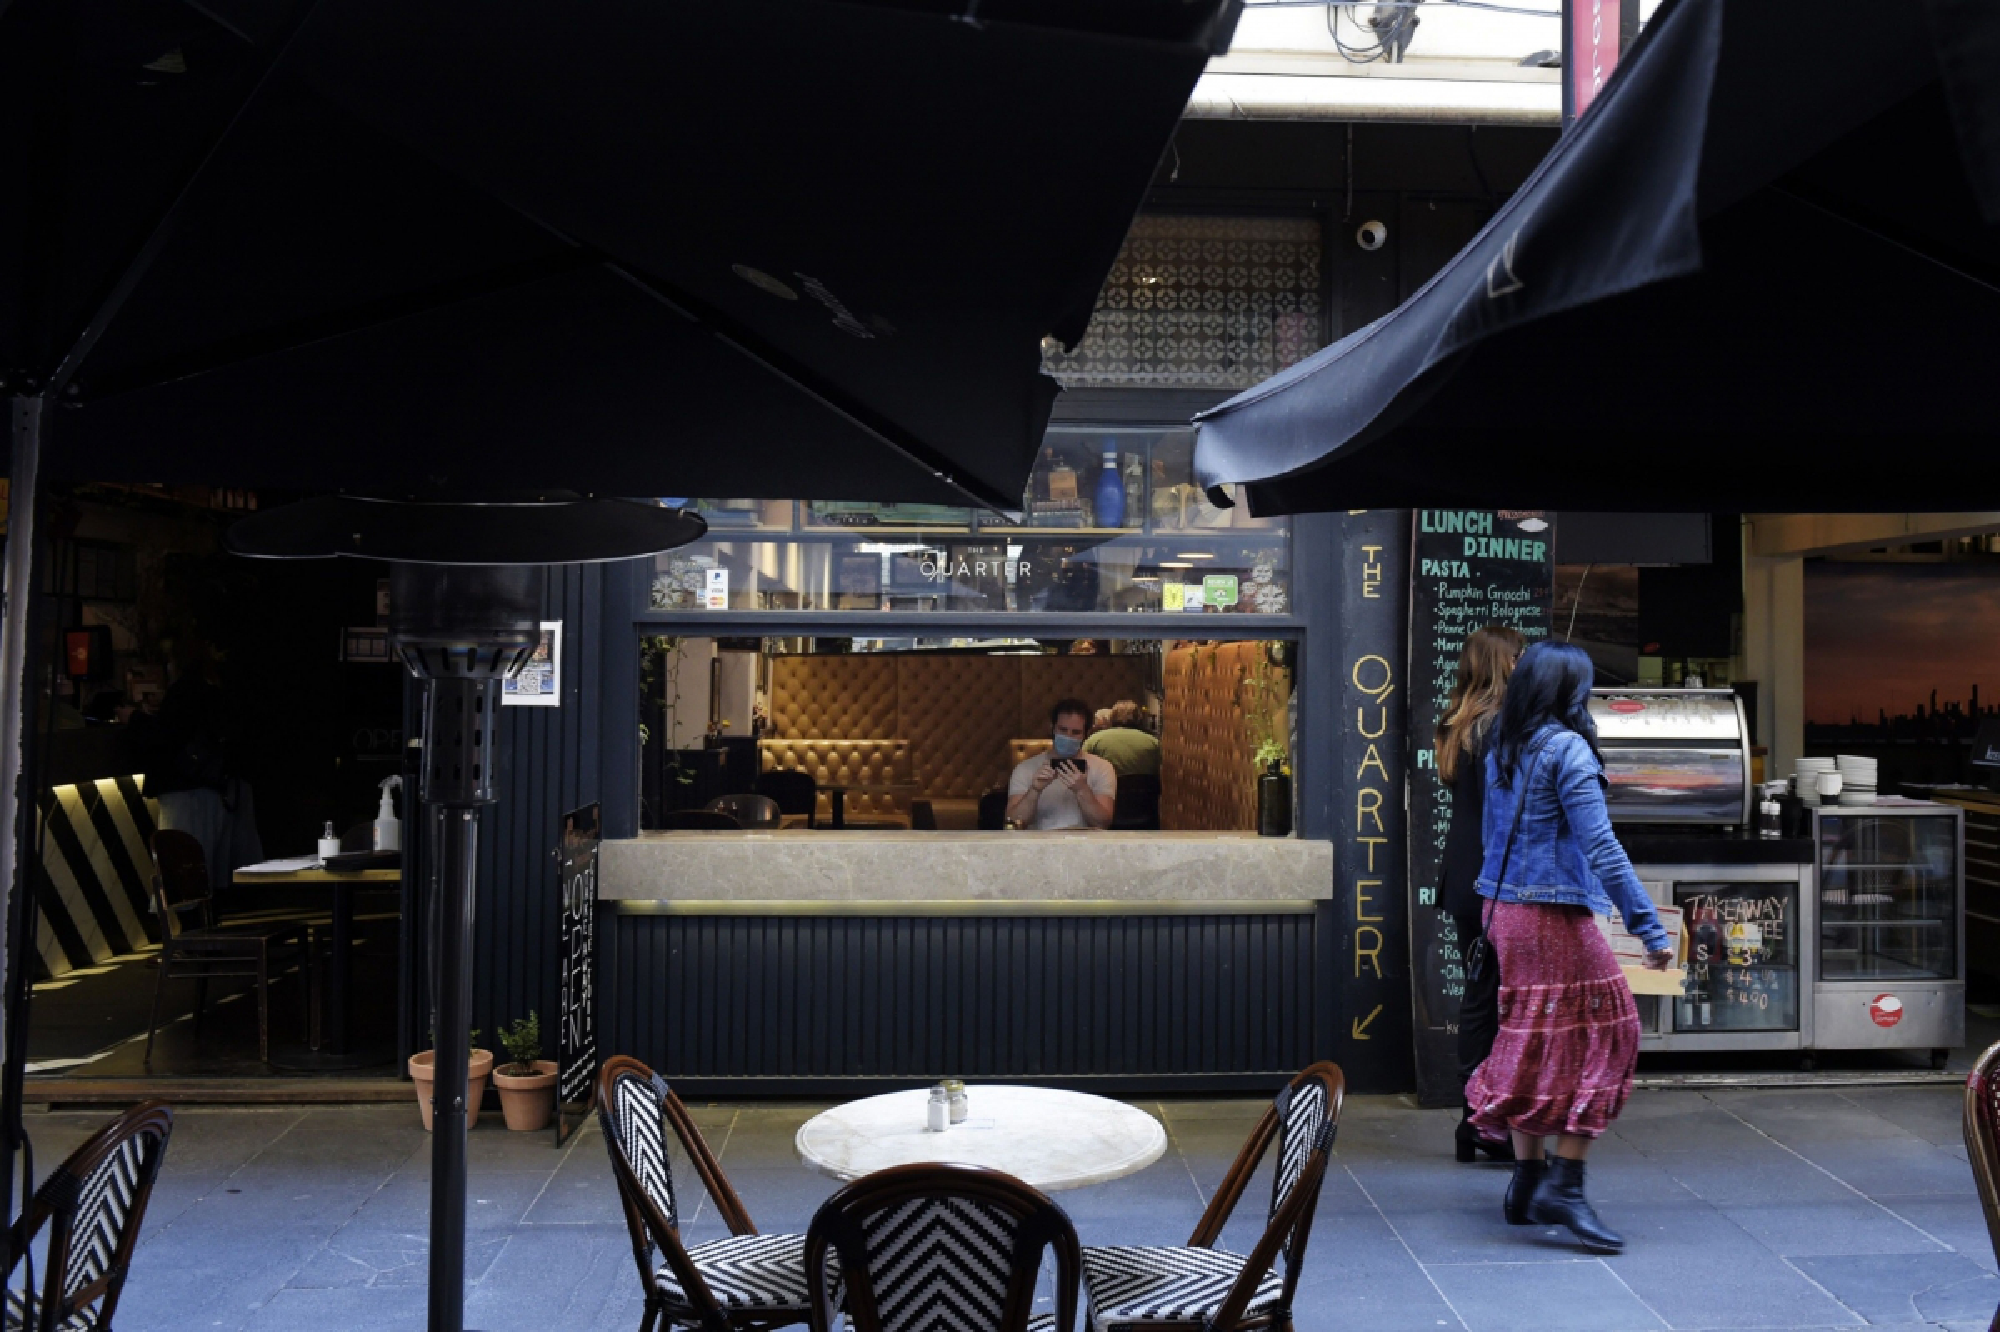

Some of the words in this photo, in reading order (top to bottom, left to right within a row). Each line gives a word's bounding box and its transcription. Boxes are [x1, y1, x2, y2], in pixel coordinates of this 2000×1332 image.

[1421, 510, 1493, 535] LUNCH
[1464, 536, 1546, 562] DINNER
[919, 561, 1032, 582] QUARTER
[1361, 544, 1383, 598] THE
[1421, 558, 1471, 578] PASTA
[1439, 581, 1484, 603] Pumpkin
[1487, 582, 1531, 601] Gnocchi
[1492, 602, 1541, 623] Bolognese
[1352, 654, 1396, 980] QUARTER
[1684, 894, 1789, 921] TAKEAWAY
